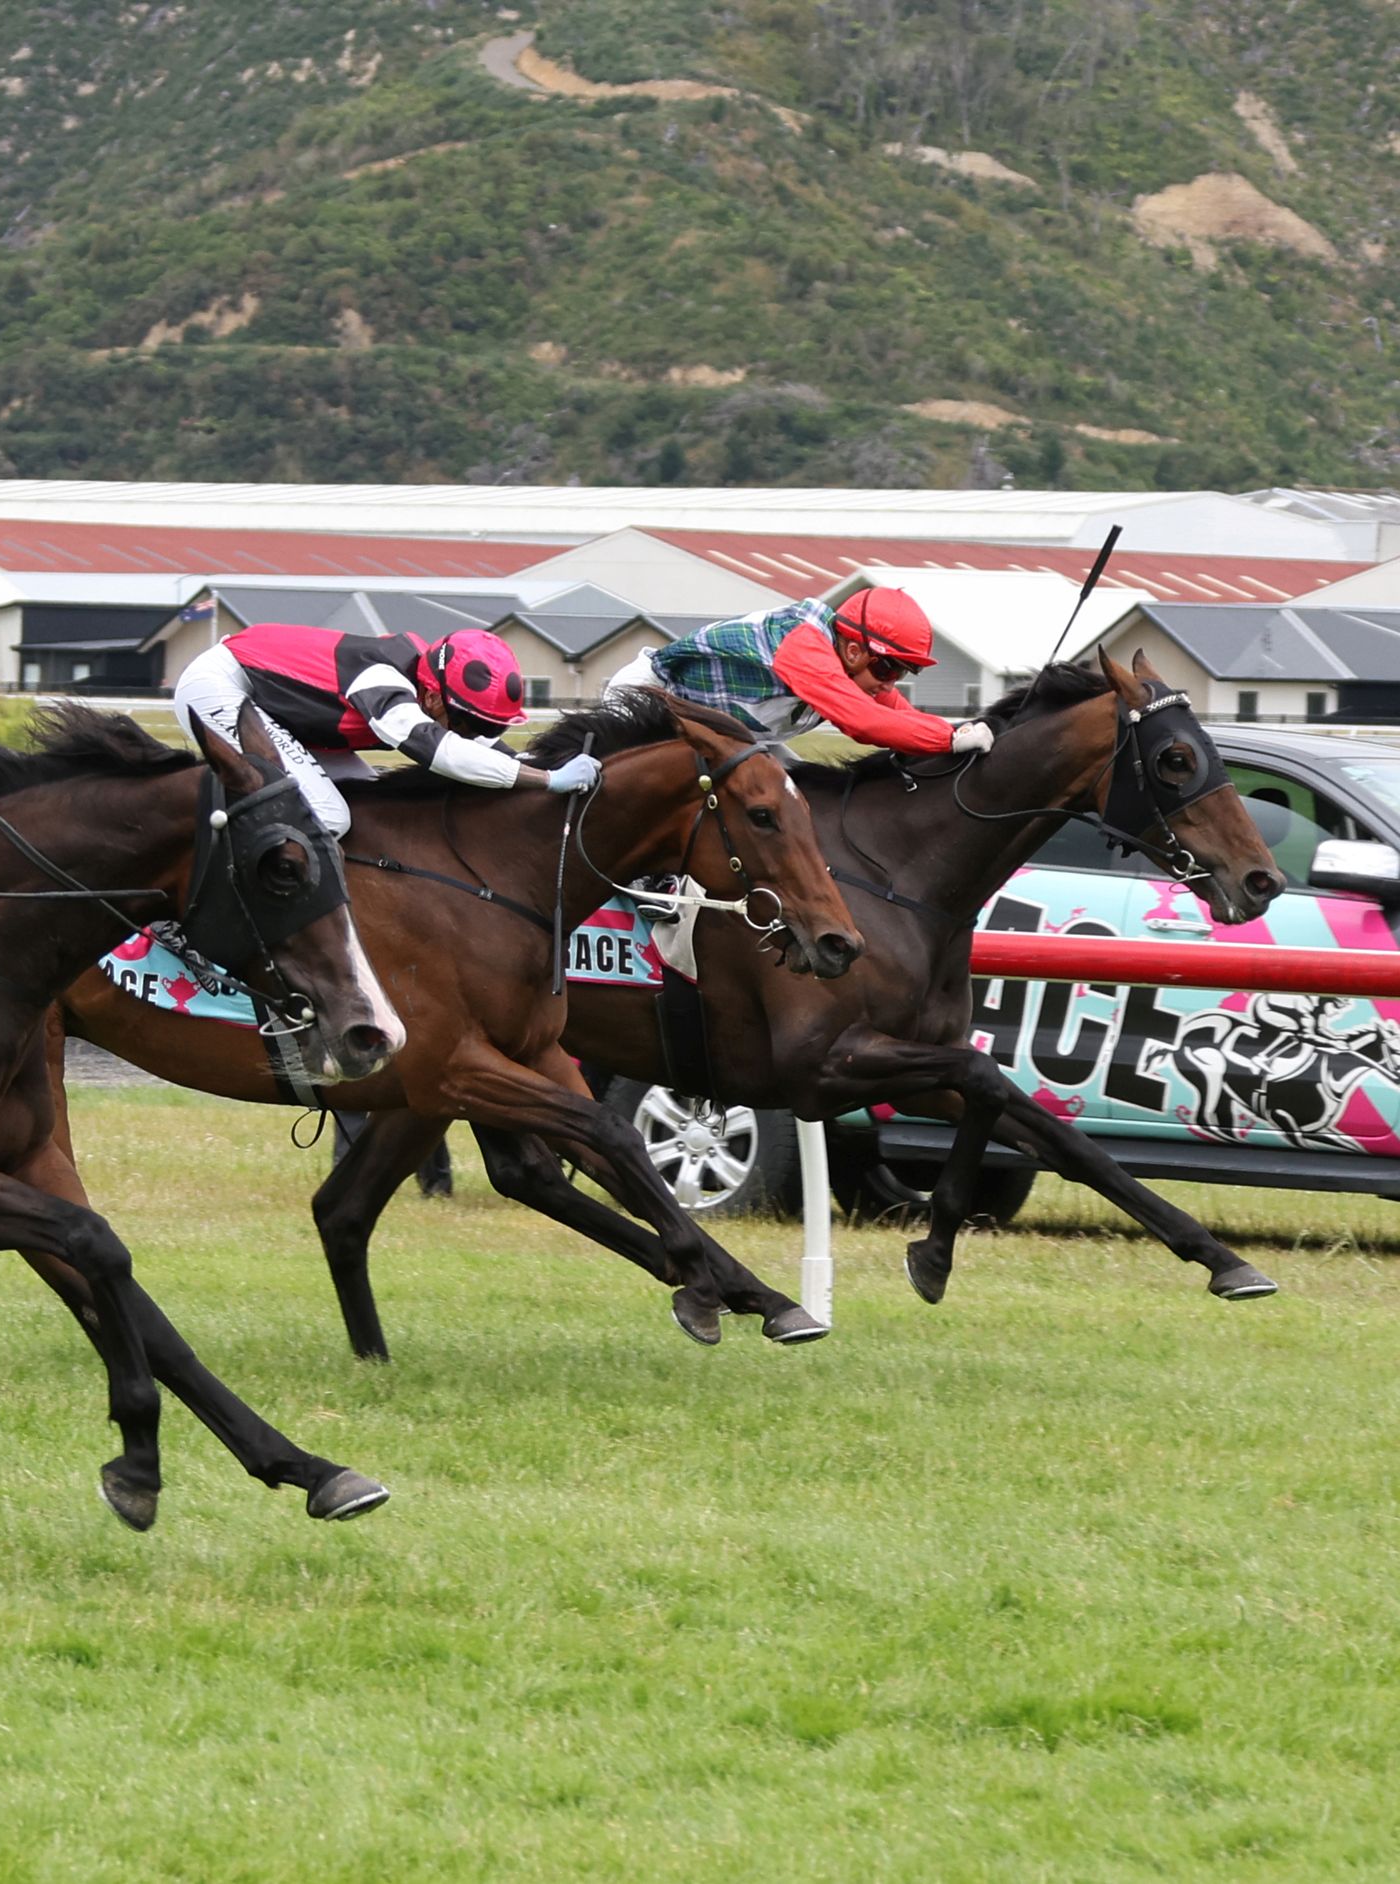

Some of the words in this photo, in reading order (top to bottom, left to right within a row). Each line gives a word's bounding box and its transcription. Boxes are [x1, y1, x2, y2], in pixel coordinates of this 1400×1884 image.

[566, 933, 634, 975] ACE
[102, 959, 160, 1004] ACE
[970, 894, 1182, 1113] ACE
